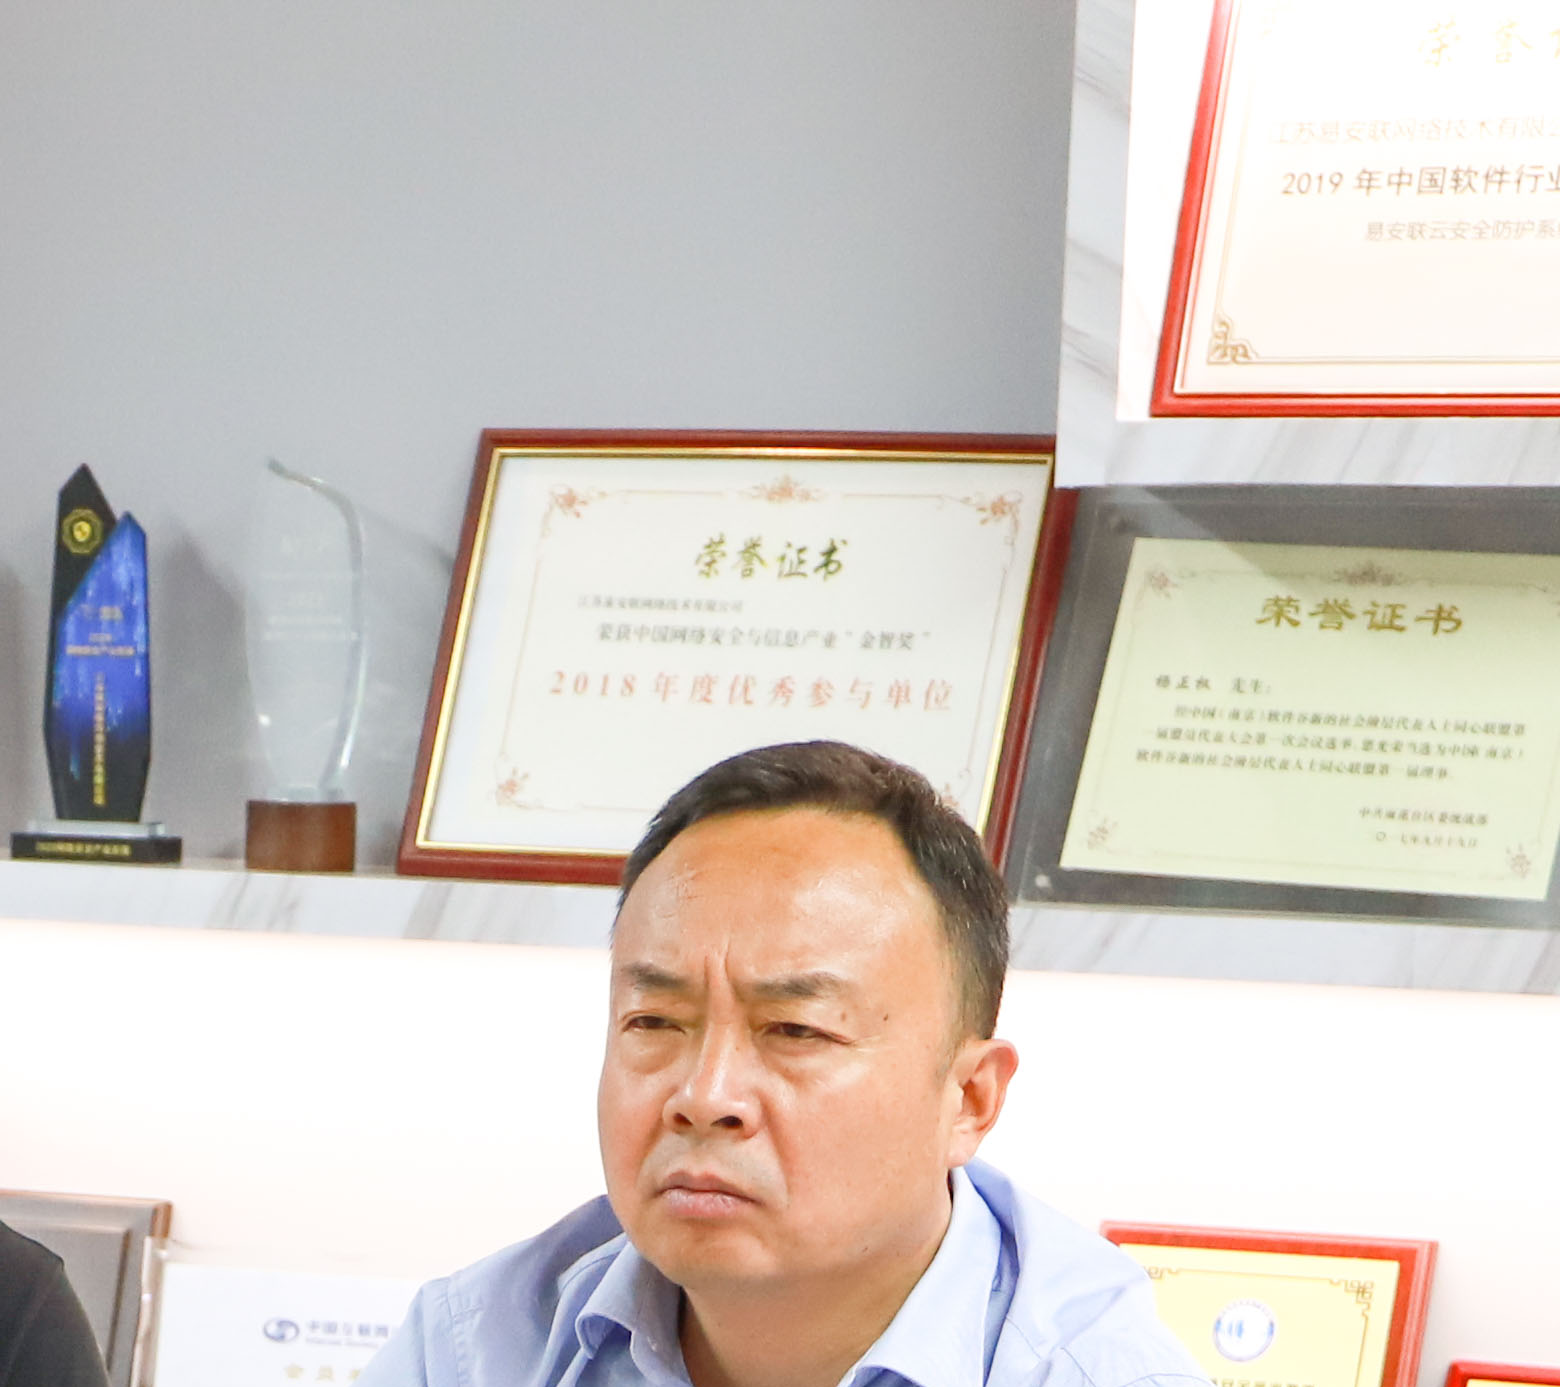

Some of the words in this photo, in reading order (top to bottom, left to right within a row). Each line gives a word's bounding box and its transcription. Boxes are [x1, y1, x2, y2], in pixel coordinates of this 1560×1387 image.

[694, 533, 850, 582] 荣誉证书
[1255, 595, 1463, 637] 荣誉证书
